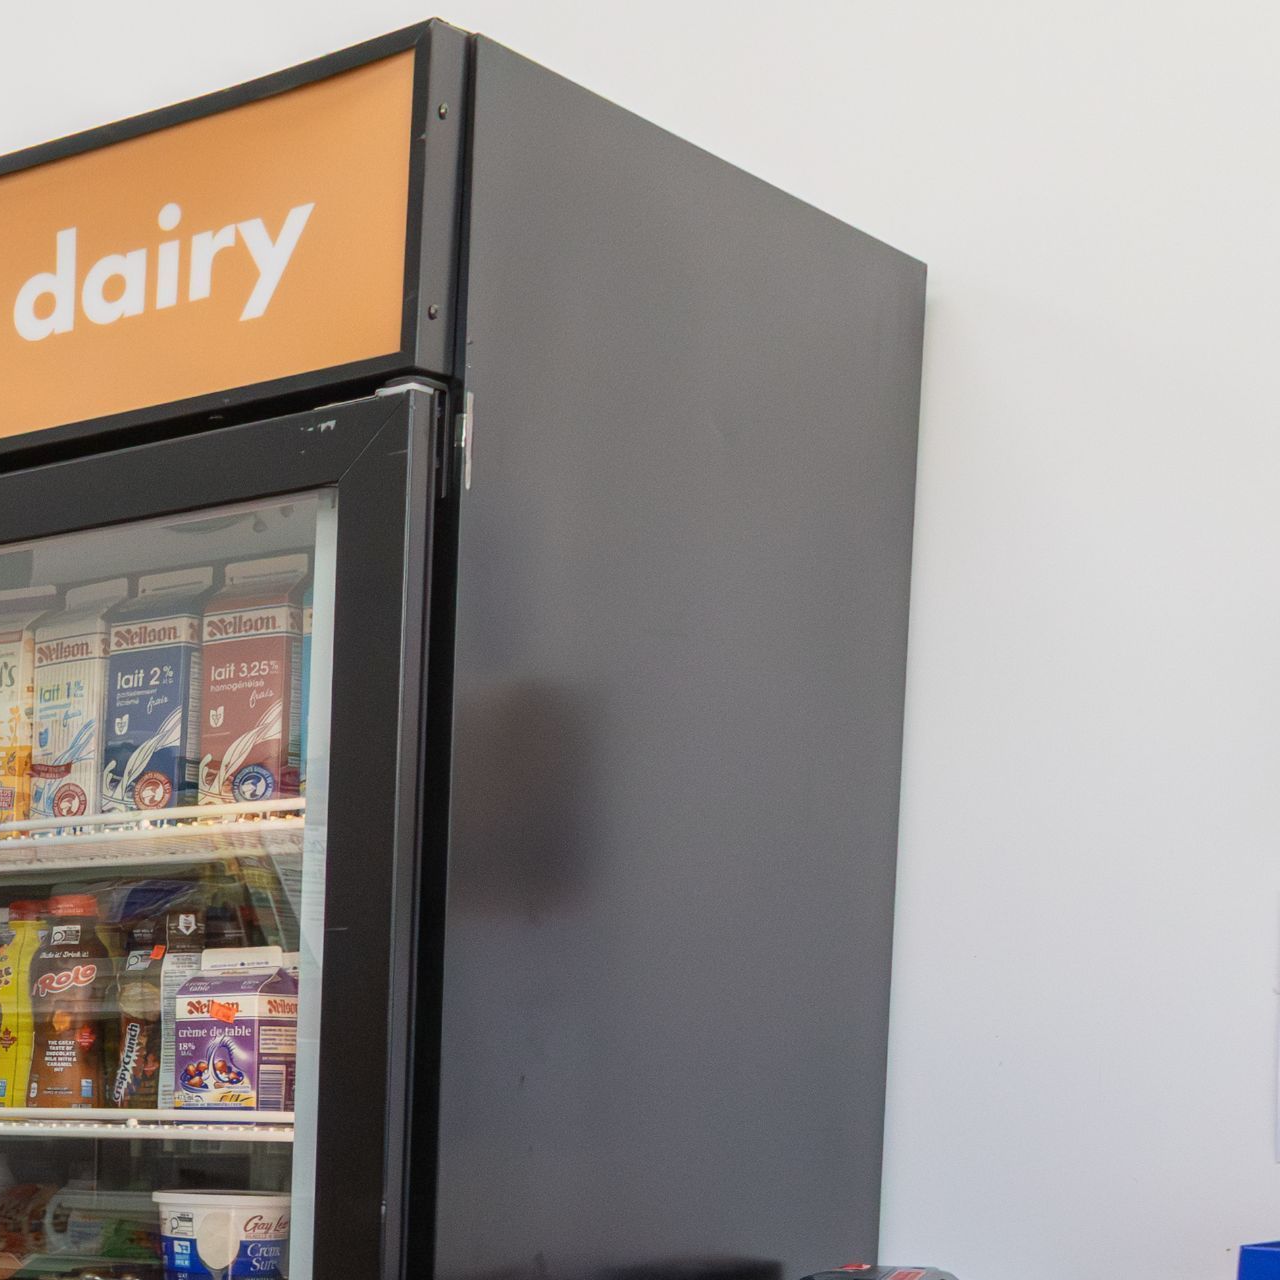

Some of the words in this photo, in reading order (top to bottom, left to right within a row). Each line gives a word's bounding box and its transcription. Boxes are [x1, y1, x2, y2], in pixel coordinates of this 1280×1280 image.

[13, 202, 315, 345] dairy
[207, 613, 281, 638] Neilson
[114, 623, 181, 649] Neilson
[116, 669, 145, 690] lait
[210, 663, 236, 682] lait
[147, 695, 169, 715] frais
[249, 688, 275, 708] frais
[178, 1026, 208, 1038] crème
[210, 1026, 223, 1037] de
[224, 1025, 251, 1037] table
[178, 1042, 196, 1051] 18%
[243, 1215, 271, 1234] Gay
